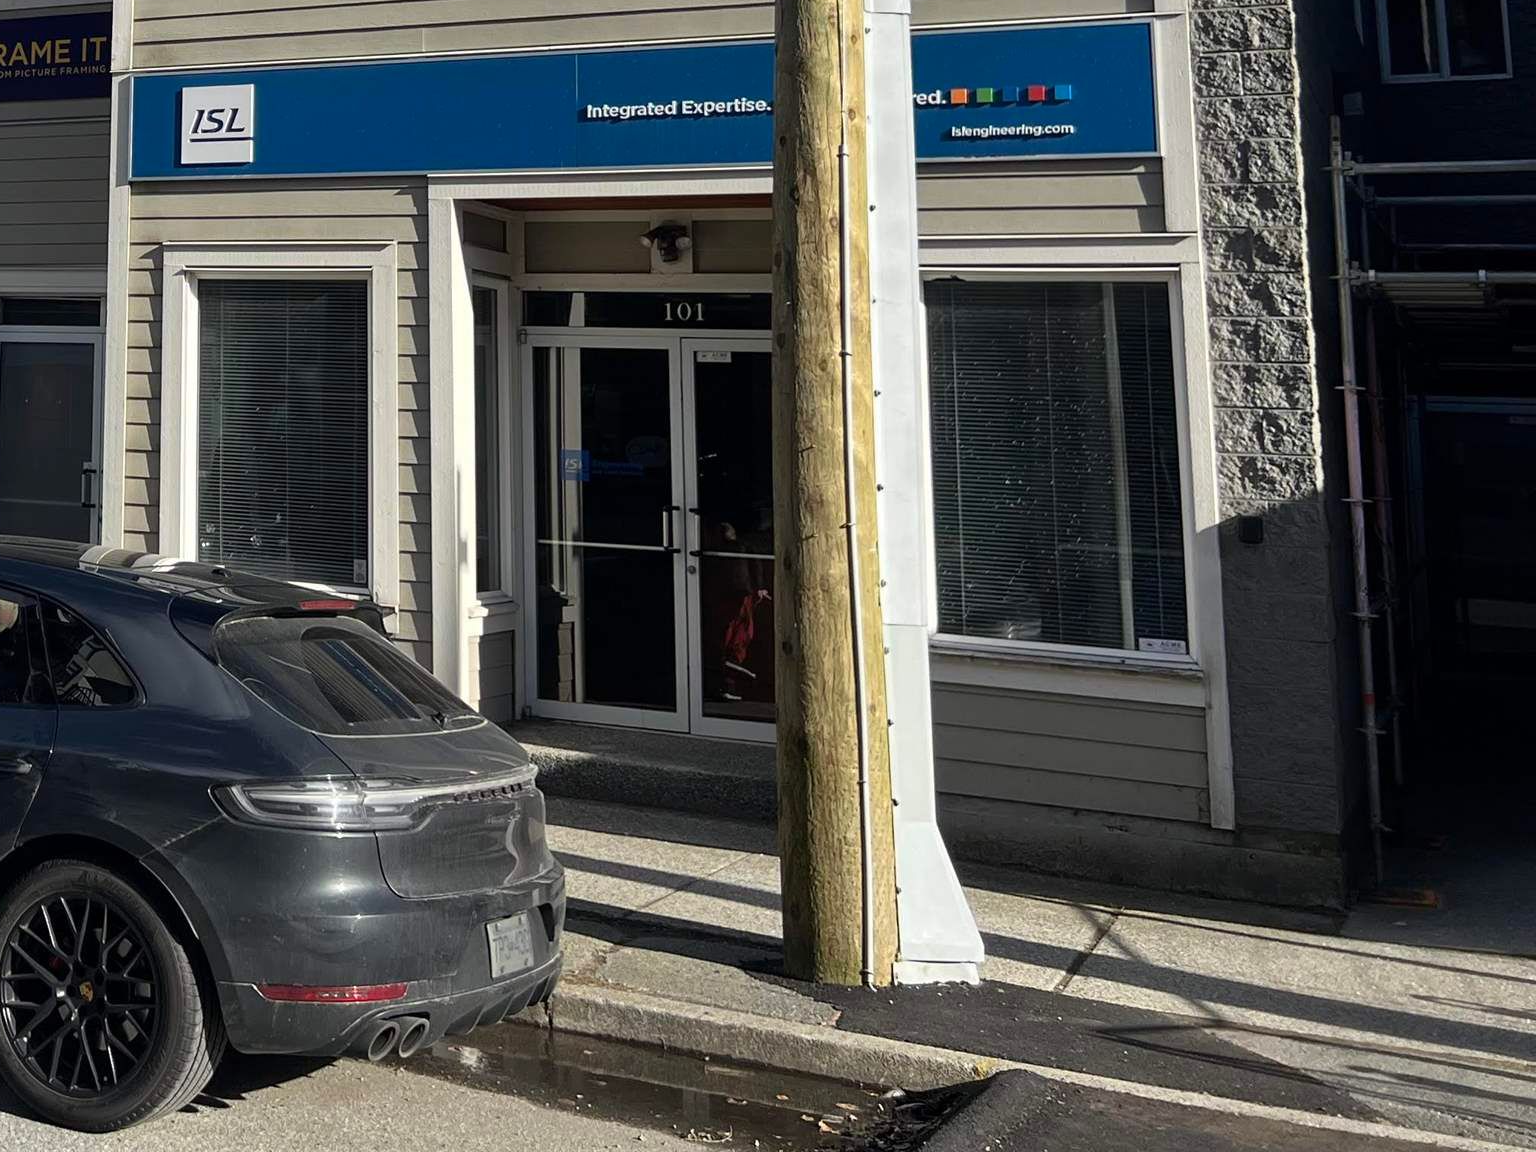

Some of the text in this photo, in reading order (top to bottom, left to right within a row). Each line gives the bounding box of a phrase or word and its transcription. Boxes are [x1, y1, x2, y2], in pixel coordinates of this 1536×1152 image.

[82, 37, 107, 62] IT
[15, 67, 57, 78] PICTURE
[59, 64, 107, 76] FRAMING
[587, 100, 677, 119] Integrated
[681, 97, 772, 115] Expertise.
[190, 108, 246, 134] ISL
[951, 123, 1075, 138] islengineering.com
[664, 303, 705, 321] 101
